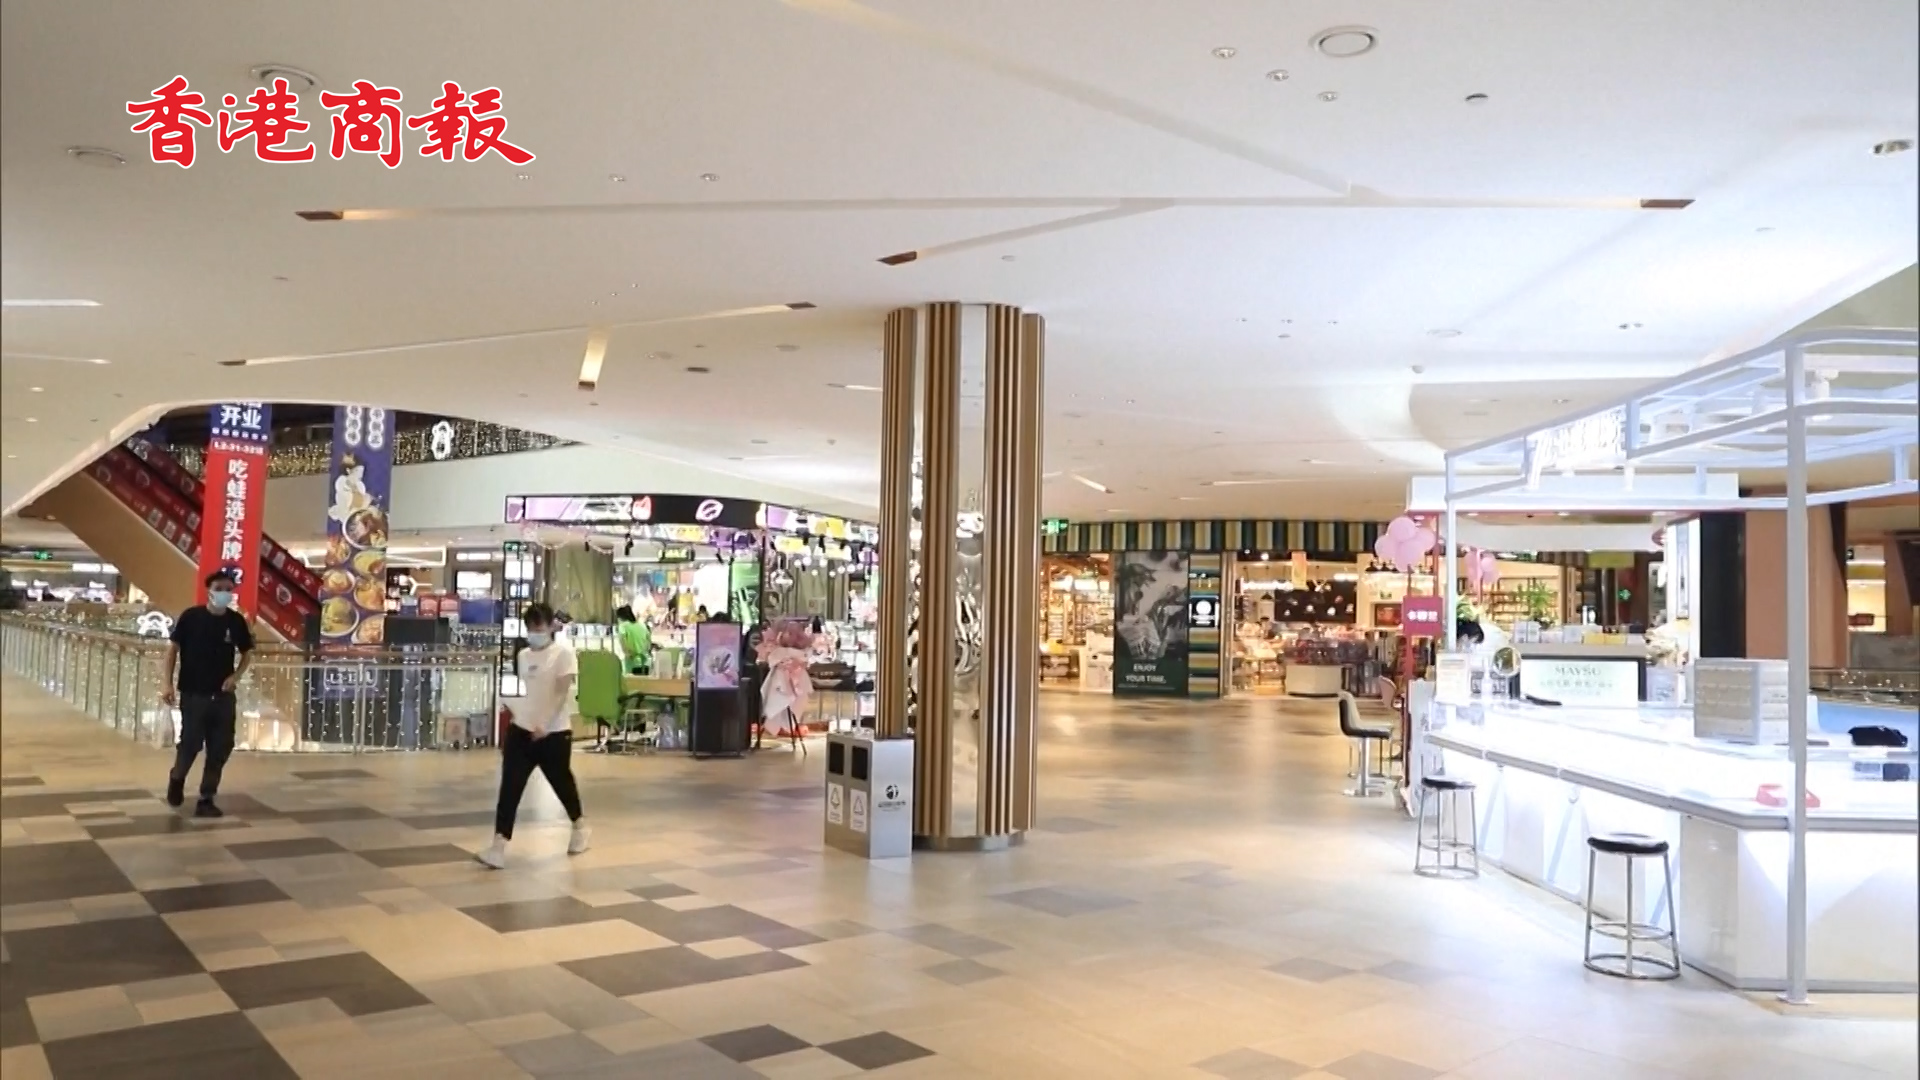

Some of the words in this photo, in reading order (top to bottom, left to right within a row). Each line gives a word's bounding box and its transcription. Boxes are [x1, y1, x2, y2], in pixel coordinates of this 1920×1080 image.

[220, 405, 262, 430] 开业
[1133, 664, 1157, 672] ENJOY
[1125, 675, 1146, 683] YOUR
